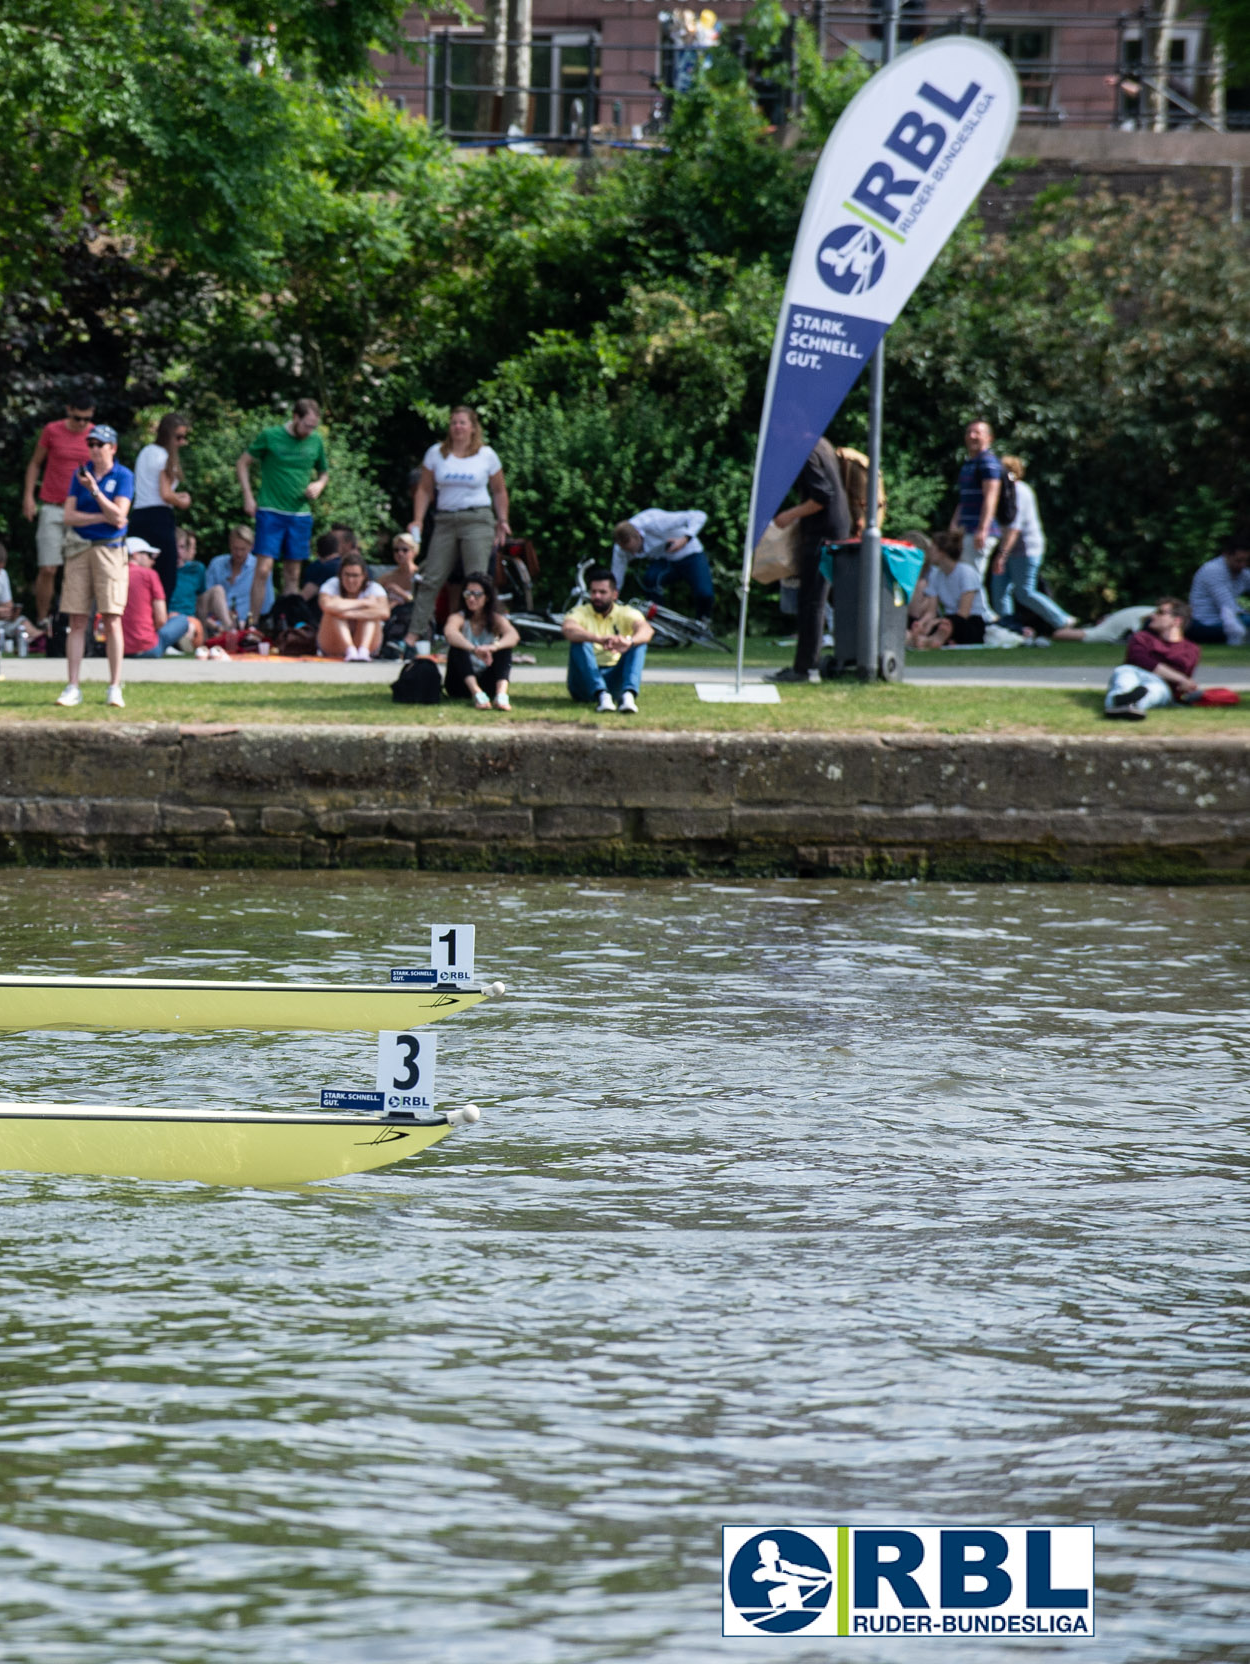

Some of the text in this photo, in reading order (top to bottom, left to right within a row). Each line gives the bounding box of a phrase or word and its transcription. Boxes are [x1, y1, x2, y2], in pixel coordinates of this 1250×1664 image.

[852, 82, 982, 224] RBL
[898, 93, 995, 234] RUDER-BUNDESLIGA
[792, 313, 848, 337] STARK.
[789, 332, 864, 359] SCHNELL.
[785, 350, 822, 370] GUT.
[439, 929, 456, 966] 1
[450, 971, 471, 979] RBL
[393, 1035, 420, 1090] 3
[324, 1092, 381, 1101] STARK. SCHNELL.
[402, 1096, 430, 1106] RBL
